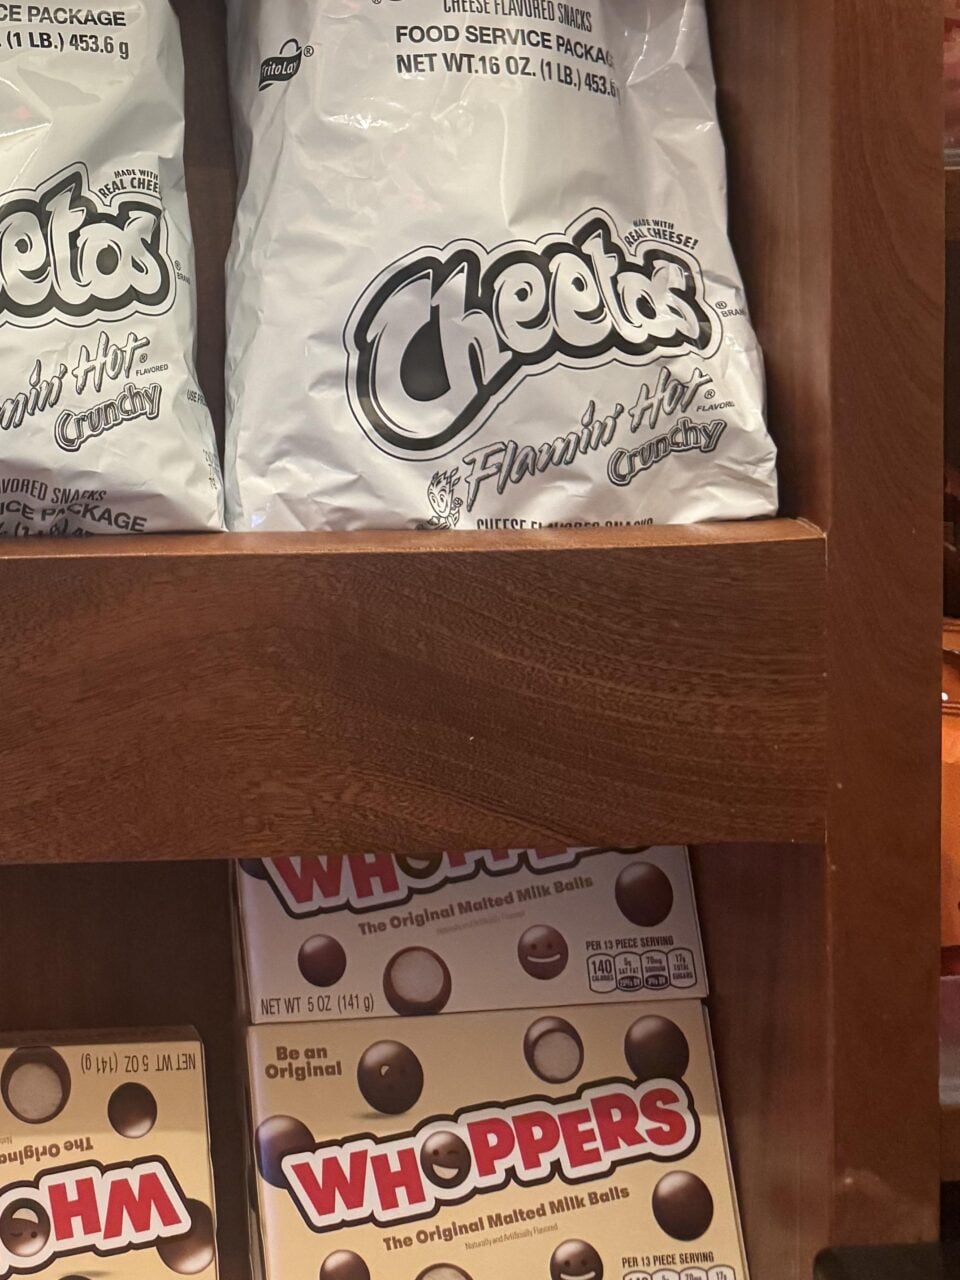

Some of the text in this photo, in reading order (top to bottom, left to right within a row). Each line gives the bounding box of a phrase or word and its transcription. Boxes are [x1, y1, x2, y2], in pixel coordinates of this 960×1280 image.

[27, 5, 127, 27] PACKAGE
[557, 3, 592, 32] SNACKS
[6, 31, 22, 50] (1
[28, 31, 64, 52] LB.)
[68, 33, 115, 54] 453.6
[118, 39, 130, 60] g
[396, 52, 617, 97] NET WT.16 OZ. (1 LB.) 453.6
[114, 169, 159, 181] MADE WITH
[350, 214, 713, 453] Cheetos
[72, 331, 150, 395] Hot
[135, 363, 169, 376] FLAVORED
[54, 382, 162, 452] Crunchy
[463, 366, 714, 512] Flamin' Hot
[608, 416, 728, 487] Crunchy
[358, 921, 387, 936] The
[389, 904, 455, 927] Original
[457, 891, 515, 916] Malted
[517, 884, 551, 903] Milk
[554, 875, 594, 894] Balls
[591, 959, 612, 975] 140
[260, 993, 375, 1015] NET WT 5 OZ (141 g)
[80, 1051, 196, 1075] NET WT 5 OZ (141 g)
[276, 1045, 328, 1061] Be an
[264, 1060, 343, 1082] Original
[63, 1136, 93, 1152] The
[291, 1087, 688, 1218] WHOPPERS
[383, 1185, 630, 1252] The Original Malted Milk Balls
[492, 1235, 504, 1244] and
[621, 1251, 715, 1269] PER 13 PIECE SERVING
